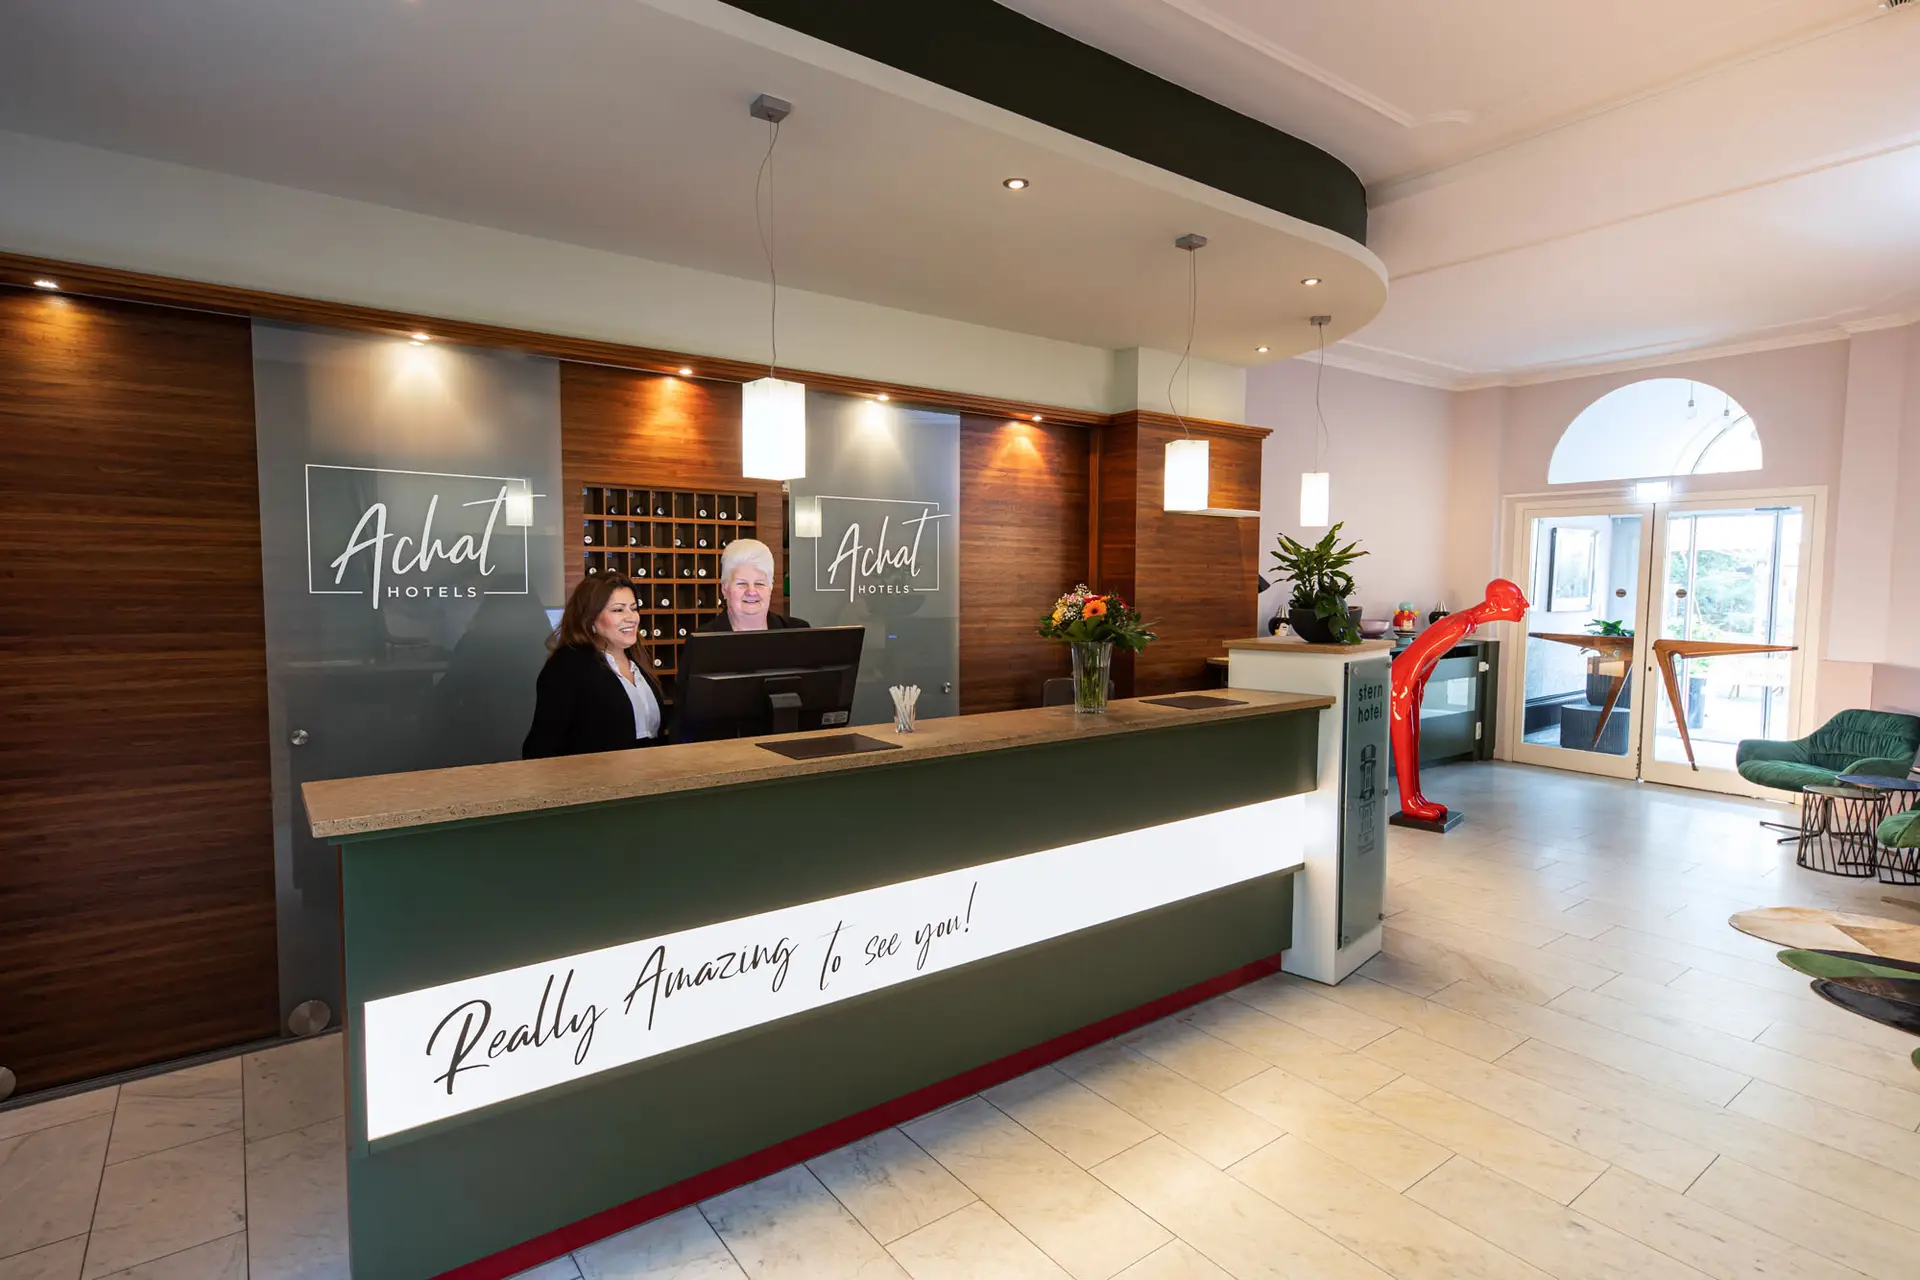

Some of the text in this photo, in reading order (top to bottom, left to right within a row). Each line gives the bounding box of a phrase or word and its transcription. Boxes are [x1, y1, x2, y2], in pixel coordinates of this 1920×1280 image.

[331, 486, 546, 609] Achat
[828, 508, 951, 603] Achat
[387, 586, 478, 598] HOTELS
[858, 584, 910, 595] HOTELS
[1358, 683, 1383, 701] stern
[1357, 702, 1383, 724] hotel
[426, 881, 978, 1095] Really Amazing to see you!
